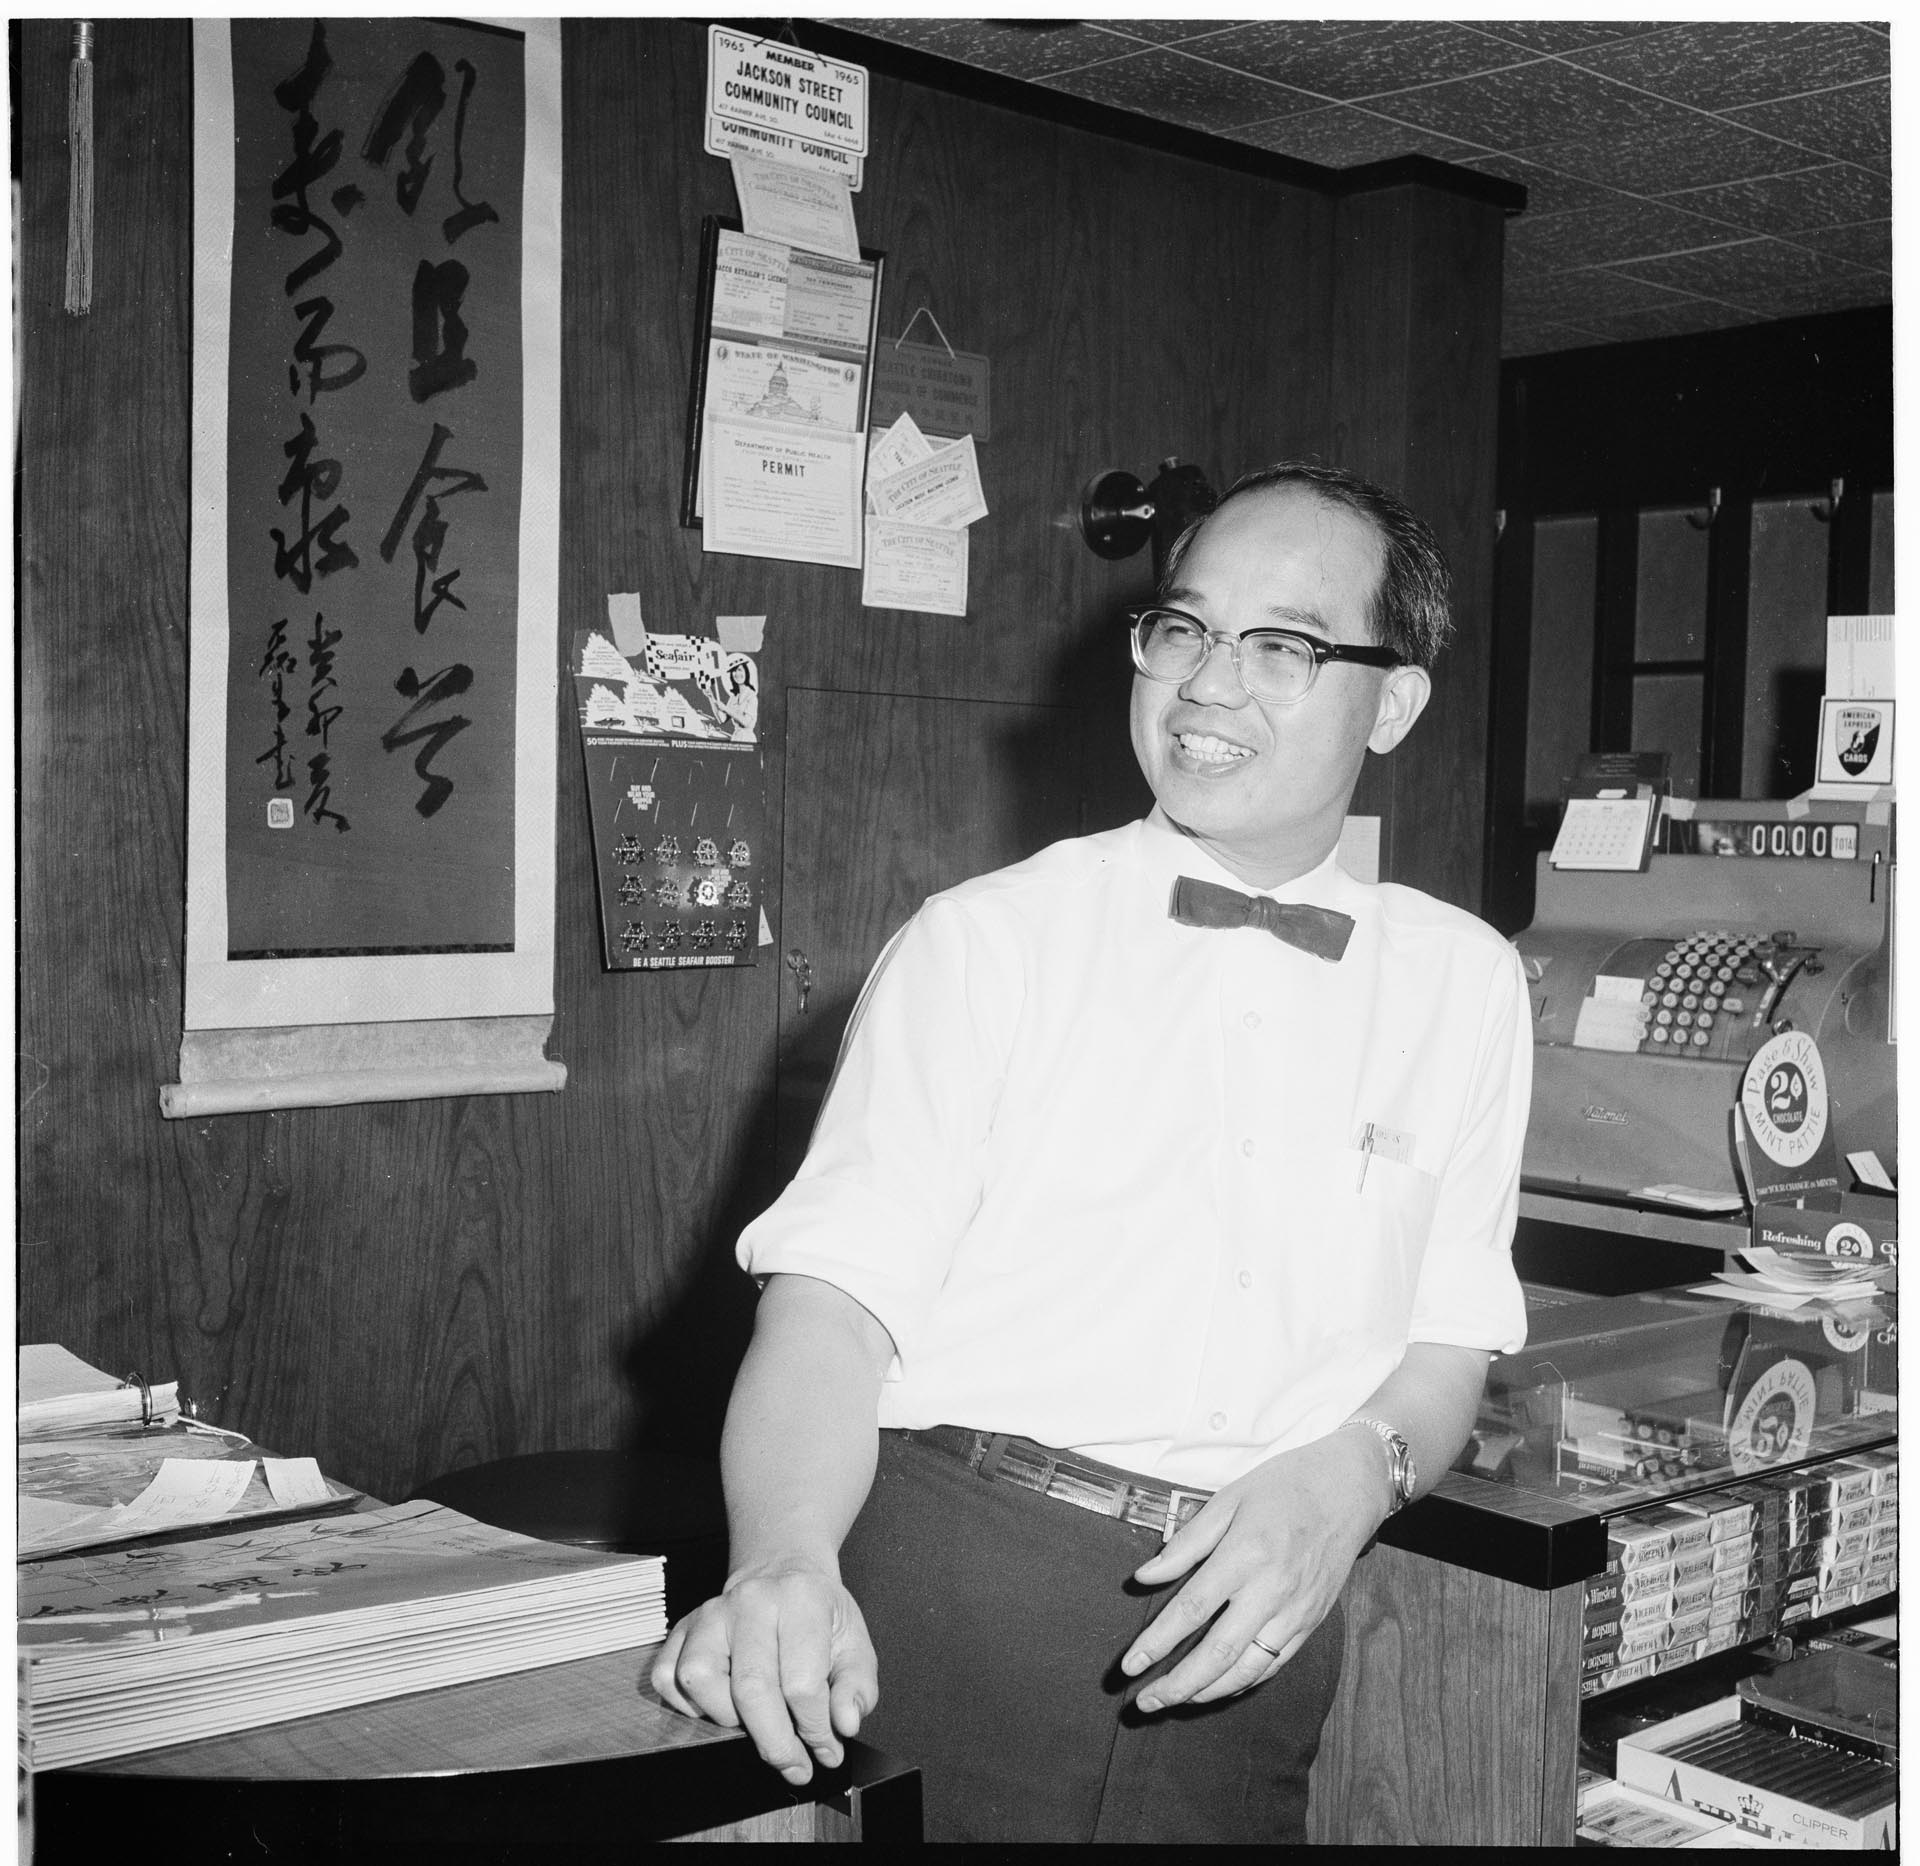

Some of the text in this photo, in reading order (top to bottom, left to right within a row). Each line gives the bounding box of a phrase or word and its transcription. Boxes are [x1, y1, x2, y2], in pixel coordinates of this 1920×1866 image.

[719, 37, 859, 85] 1965 1965
[766, 51, 815, 72] MEMBER
[737, 61, 843, 103] JACKSON STREET
[725, 81, 854, 130] COMMUNITY COUNCIL
[762, 459, 805, 477] PERMIT
[655, 649, 695, 663] Seafair
[1842, 711, 1875, 720] AMERICAN
[1844, 721, 1872, 729] EXPRESS
[586, 737, 598, 746] 50
[671, 740, 687, 748] PLUS
[1843, 753, 1868, 764] CARDS
[633, 955, 735, 968] BE A SEATTLE SEAFAIR BOOSTER!
[1747, 1050, 1779, 1095] Page
[1773, 1111, 1803, 1124] CHOCOLATE
[1754, 1107, 1821, 1155] MINT PATTIE
[1761, 1229, 1821, 1251] Refreshing
[1590, 1586, 1617, 1604] Winston
[1591, 1621, 1618, 1640] Winston
[1587, 1652, 1614, 1670] Winston
[1792, 1813, 1848, 1841] CLIPPER
